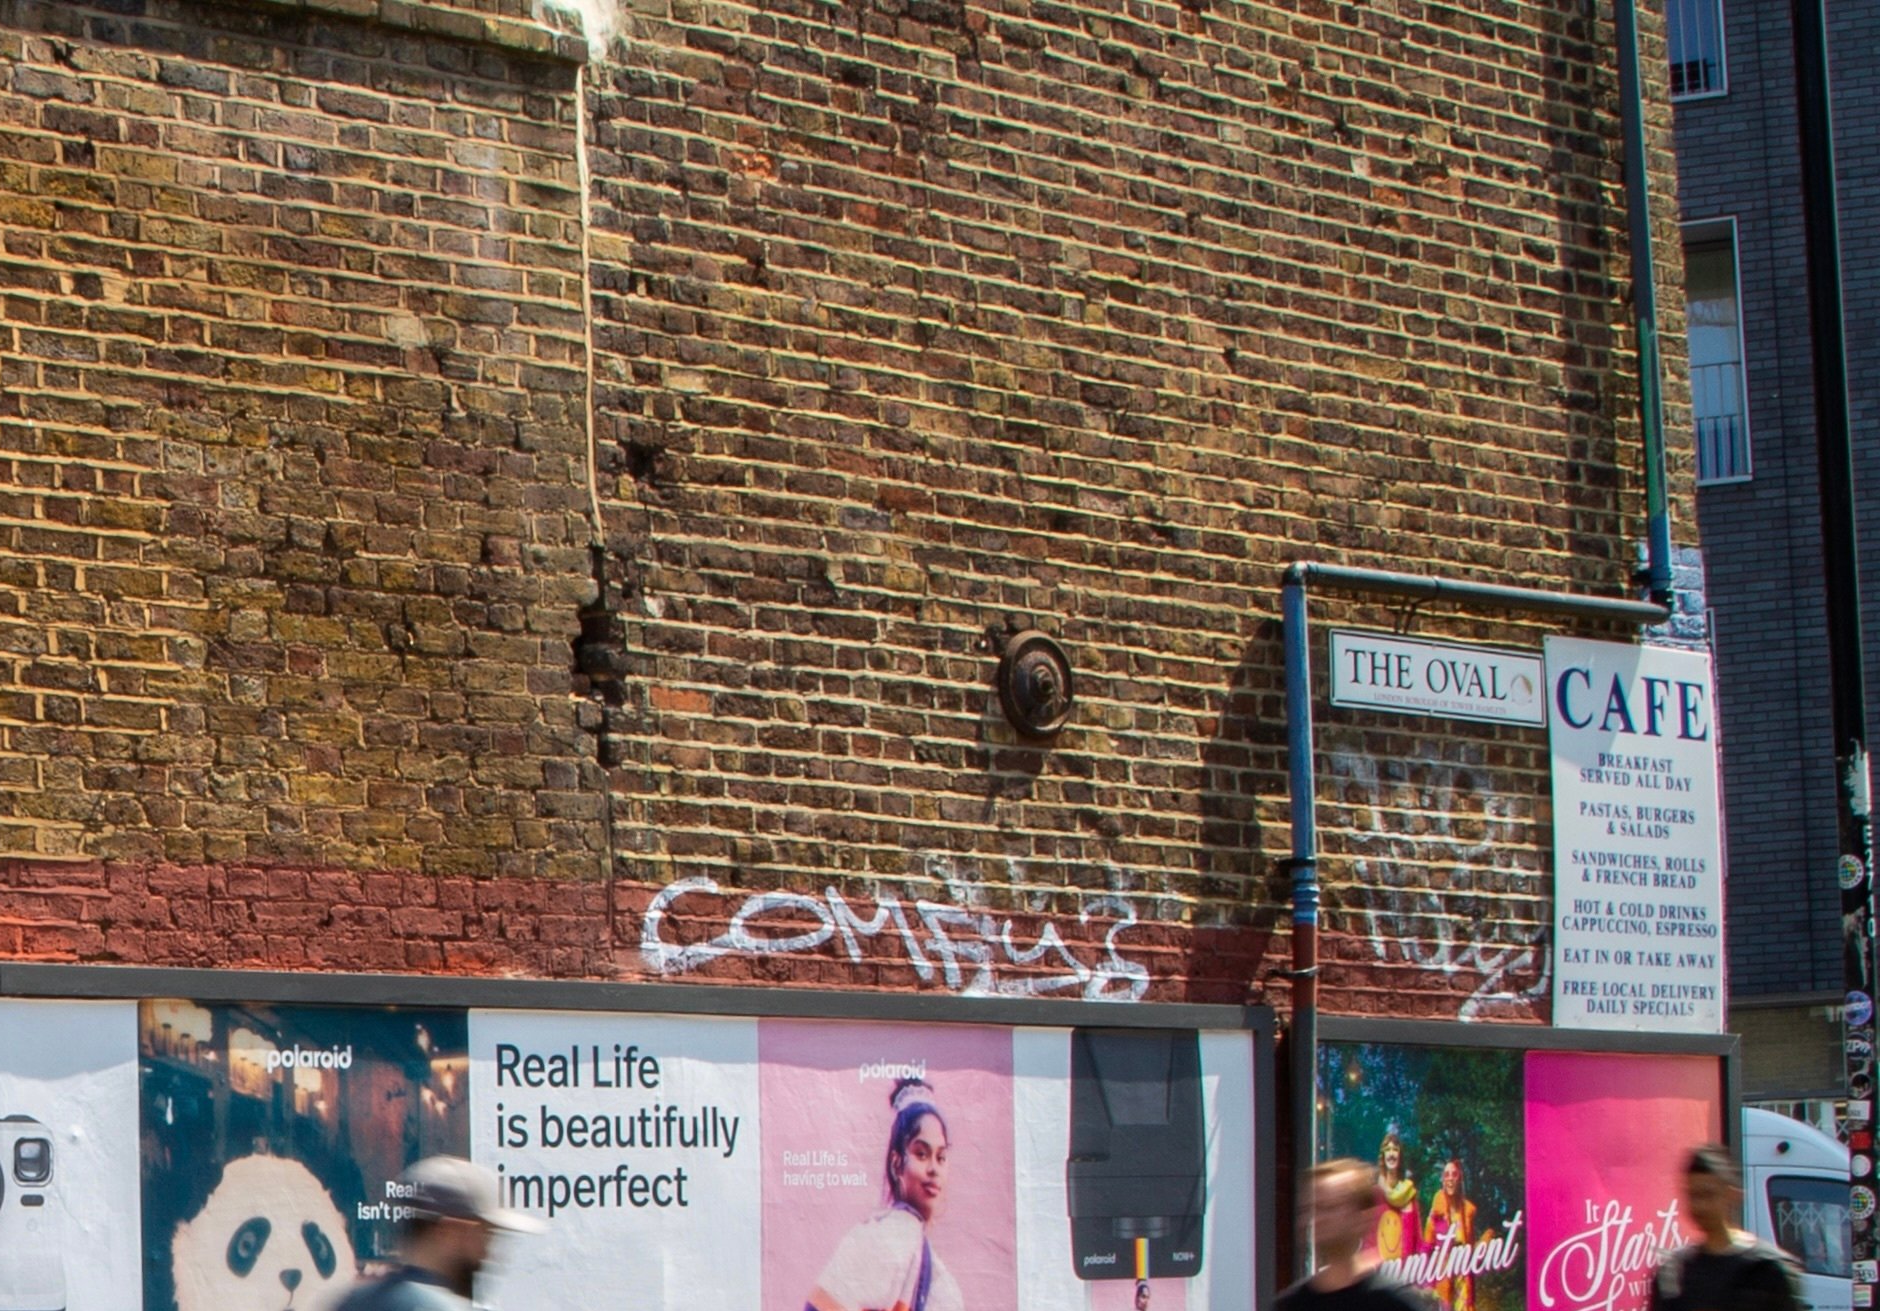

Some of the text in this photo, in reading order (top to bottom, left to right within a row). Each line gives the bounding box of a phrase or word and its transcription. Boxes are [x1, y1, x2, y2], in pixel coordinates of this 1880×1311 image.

[1345, 649, 1507, 701] THE OVAL
[1556, 667, 1708, 742] CAFE
[1598, 752, 1673, 773] BREAKFAST
[1580, 769, 1692, 793] SERVED ALL DAY
[1580, 801, 1695, 825] PASTAS, BURGERS
[1607, 821, 1670, 840] & SALADS
[1571, 850, 1705, 873] SANDWICHES, ROLLS
[1582, 868, 1697, 889] & FRENCH BREAD
[1574, 900, 1707, 921] HOT & COLD DRINKS
[1562, 916, 1718, 939] CAPPUCCINO, ESPRESSO
[1563, 948, 1716, 969] EAT IN OR TAKE AWAY
[1563, 980, 1717, 1001] FREE LOCAL DELIVERY
[1586, 999, 1695, 1016] DAILY SPECIALS
[266, 1044, 352, 1073] polaroid
[496, 1044, 660, 1089] Real Life
[859, 1058, 927, 1084] polaroid
[497, 1104, 740, 1158] is beautifully
[783, 1150, 848, 1166] Real Life is
[385, 1181, 418, 1199] Real
[498, 1164, 689, 1217] imperfect
[783, 1171, 868, 1189] having to wait
[357, 1202, 391, 1221] isn't
[1585, 1198, 1600, 1224] It
[1378, 1210, 1523, 1285] mmitment
[1539, 1198, 1690, 1308] Starts
[1083, 1252, 1195, 1267] polaroid NOW+
[1628, 1272, 1654, 1297] wit
